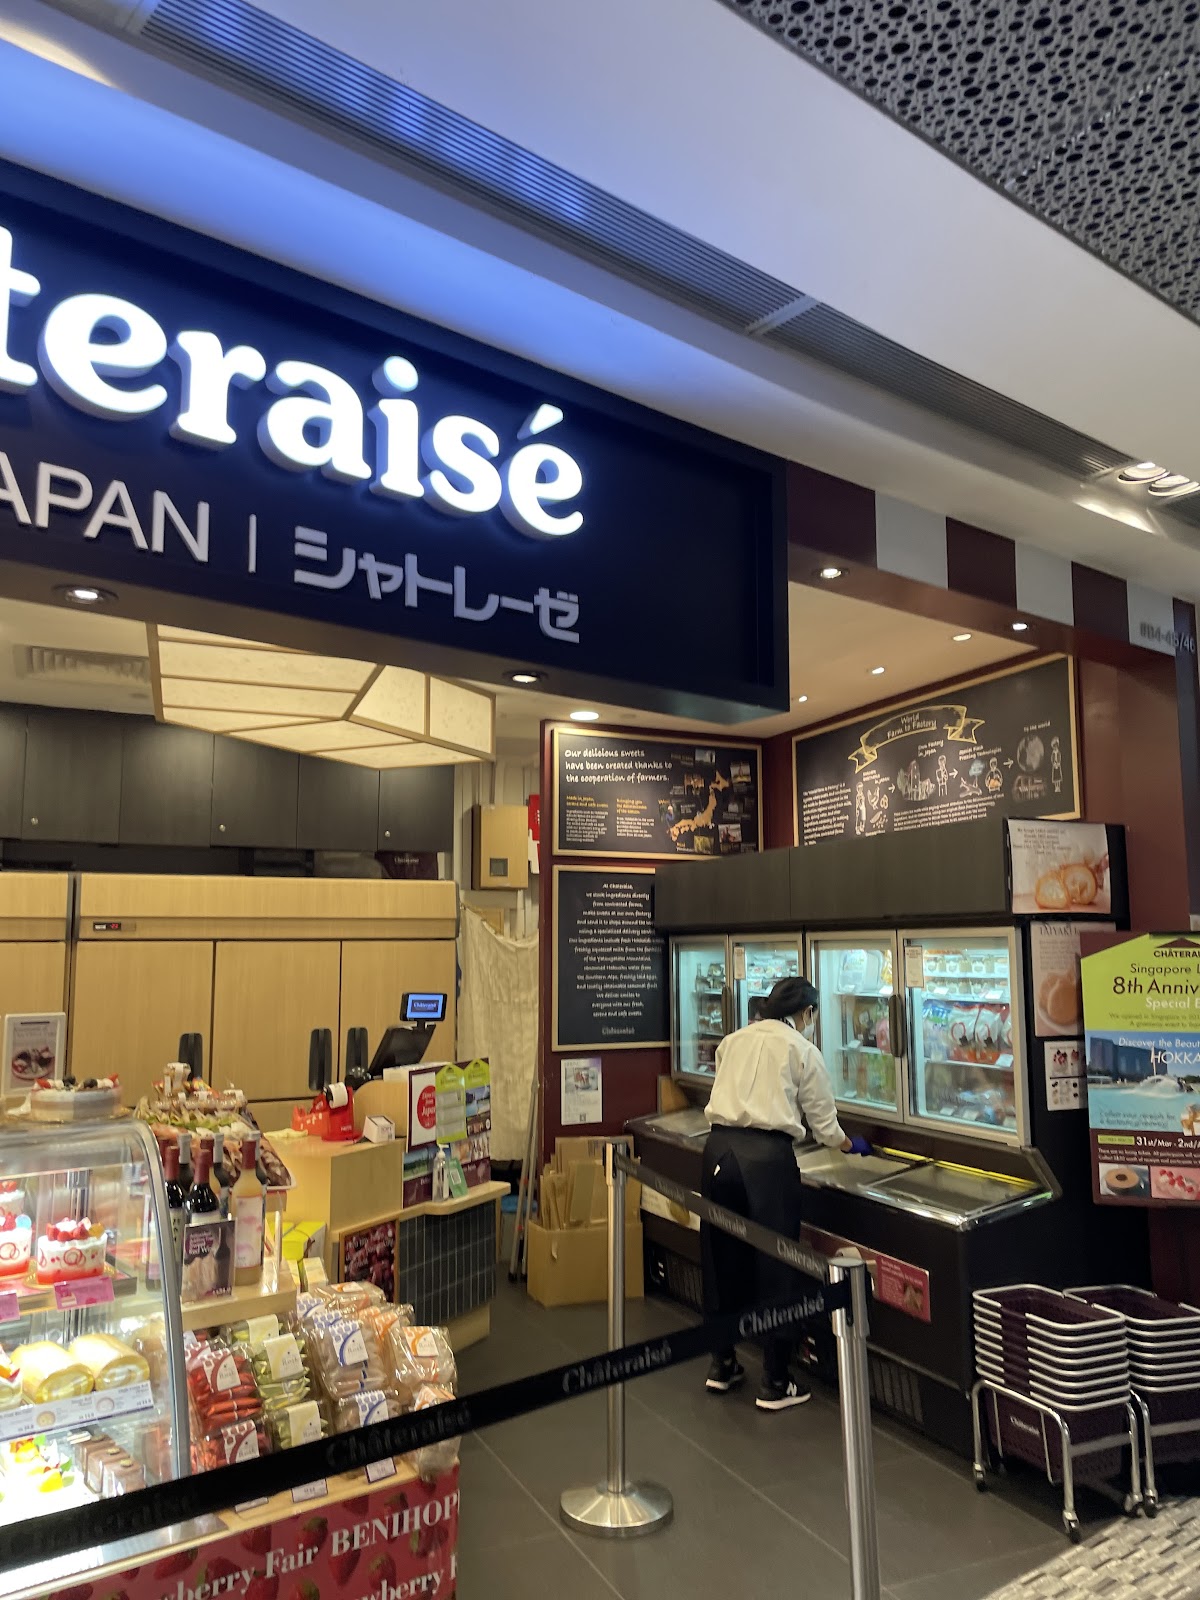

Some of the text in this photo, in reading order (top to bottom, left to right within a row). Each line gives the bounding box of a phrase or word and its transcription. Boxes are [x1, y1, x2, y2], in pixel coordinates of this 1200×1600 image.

[294, 526, 580, 644] シャトレーゼ
[565, 748, 645, 757] Our delicious sweets
[565, 761, 672, 770] have been created thanks to
[566, 772, 669, 785] the cooperation of farmers.
[1130, 963, 1191, 977] Singapore
[1113, 976, 1143, 994] 8th
[1145, 997, 1190, 1010] Special
[1119, 1037, 1156, 1047] Discover
[1159, 1038, 1173, 1047] the
[160, 1489, 460, 1600] berry Fair BENIHOP
